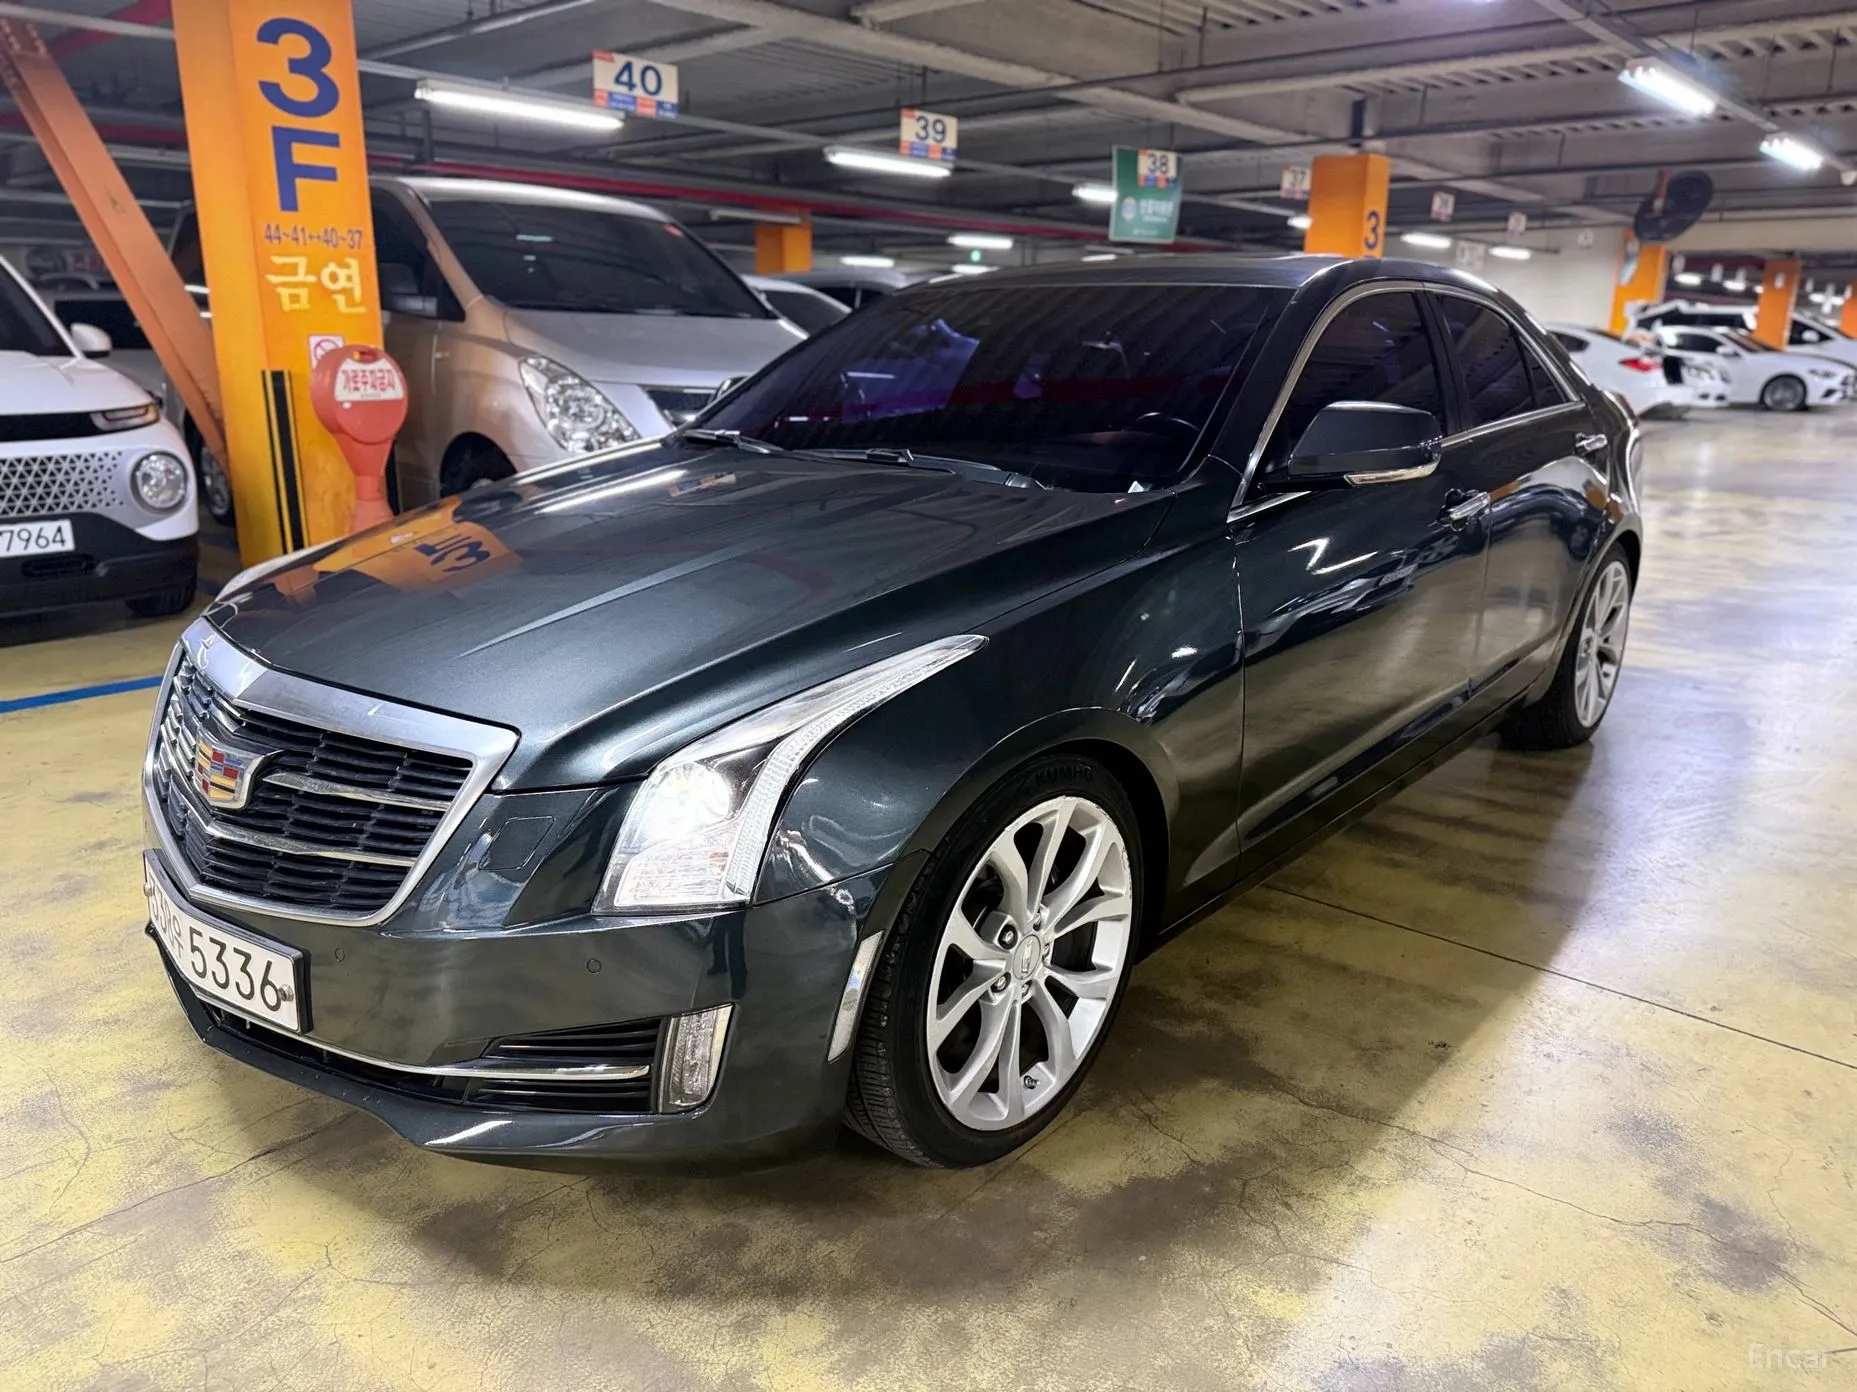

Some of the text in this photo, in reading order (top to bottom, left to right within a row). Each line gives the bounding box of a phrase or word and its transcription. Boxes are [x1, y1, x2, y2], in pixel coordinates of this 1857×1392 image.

[614, 61, 662, 96] 40
[915, 115, 946, 143] 39
[1148, 153, 1169, 174] 38
[265, 255, 367, 313] 금연
[0, 525, 65, 552] 7964
[1035, 764, 1094, 786] KUMHO
[189, 926, 283, 1012] 5336
